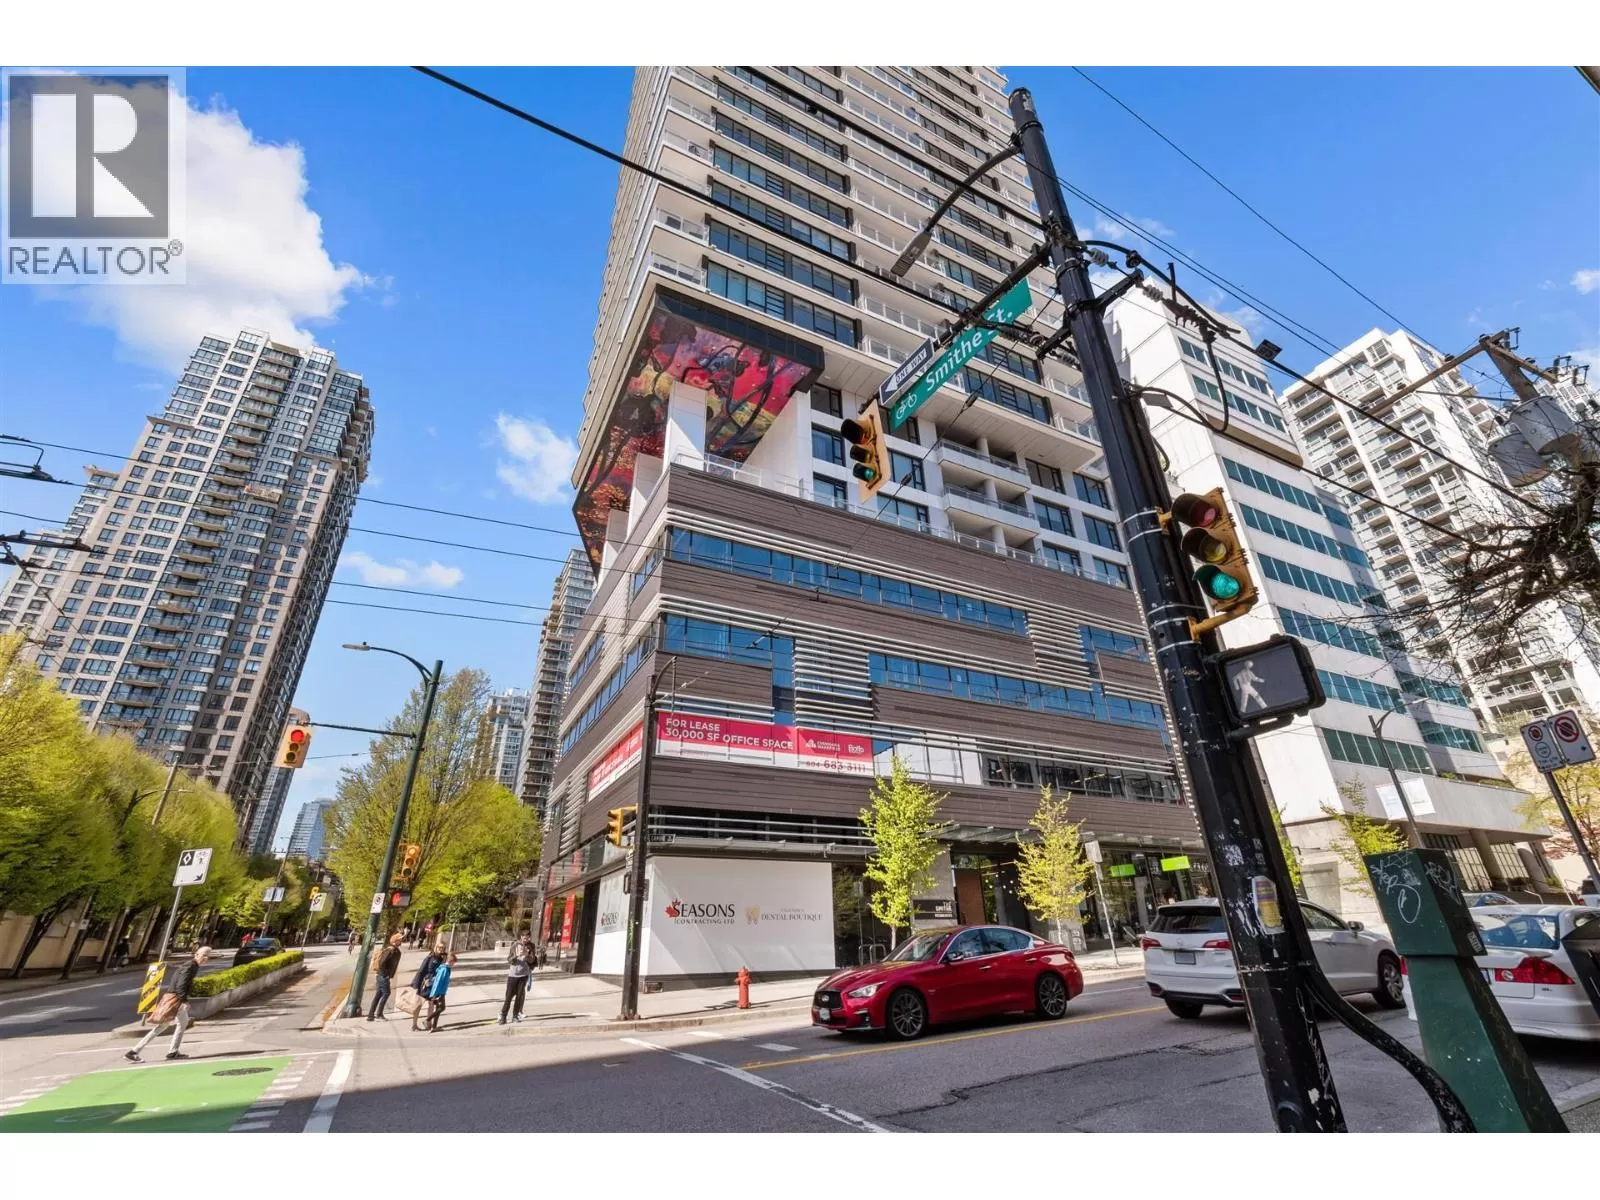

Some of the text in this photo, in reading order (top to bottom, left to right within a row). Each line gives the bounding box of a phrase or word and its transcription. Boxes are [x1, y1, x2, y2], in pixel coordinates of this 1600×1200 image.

[895, 348, 927, 383] ONE WAY
[926, 331, 982, 392] Smithe
[666, 717, 721, 732] FOR LEASE
[665, 727, 793, 750] 30,000 SF OFFICE SPACE
[673, 903, 736, 918] SEASONS
[761, 913, 788, 921] DENTAL
